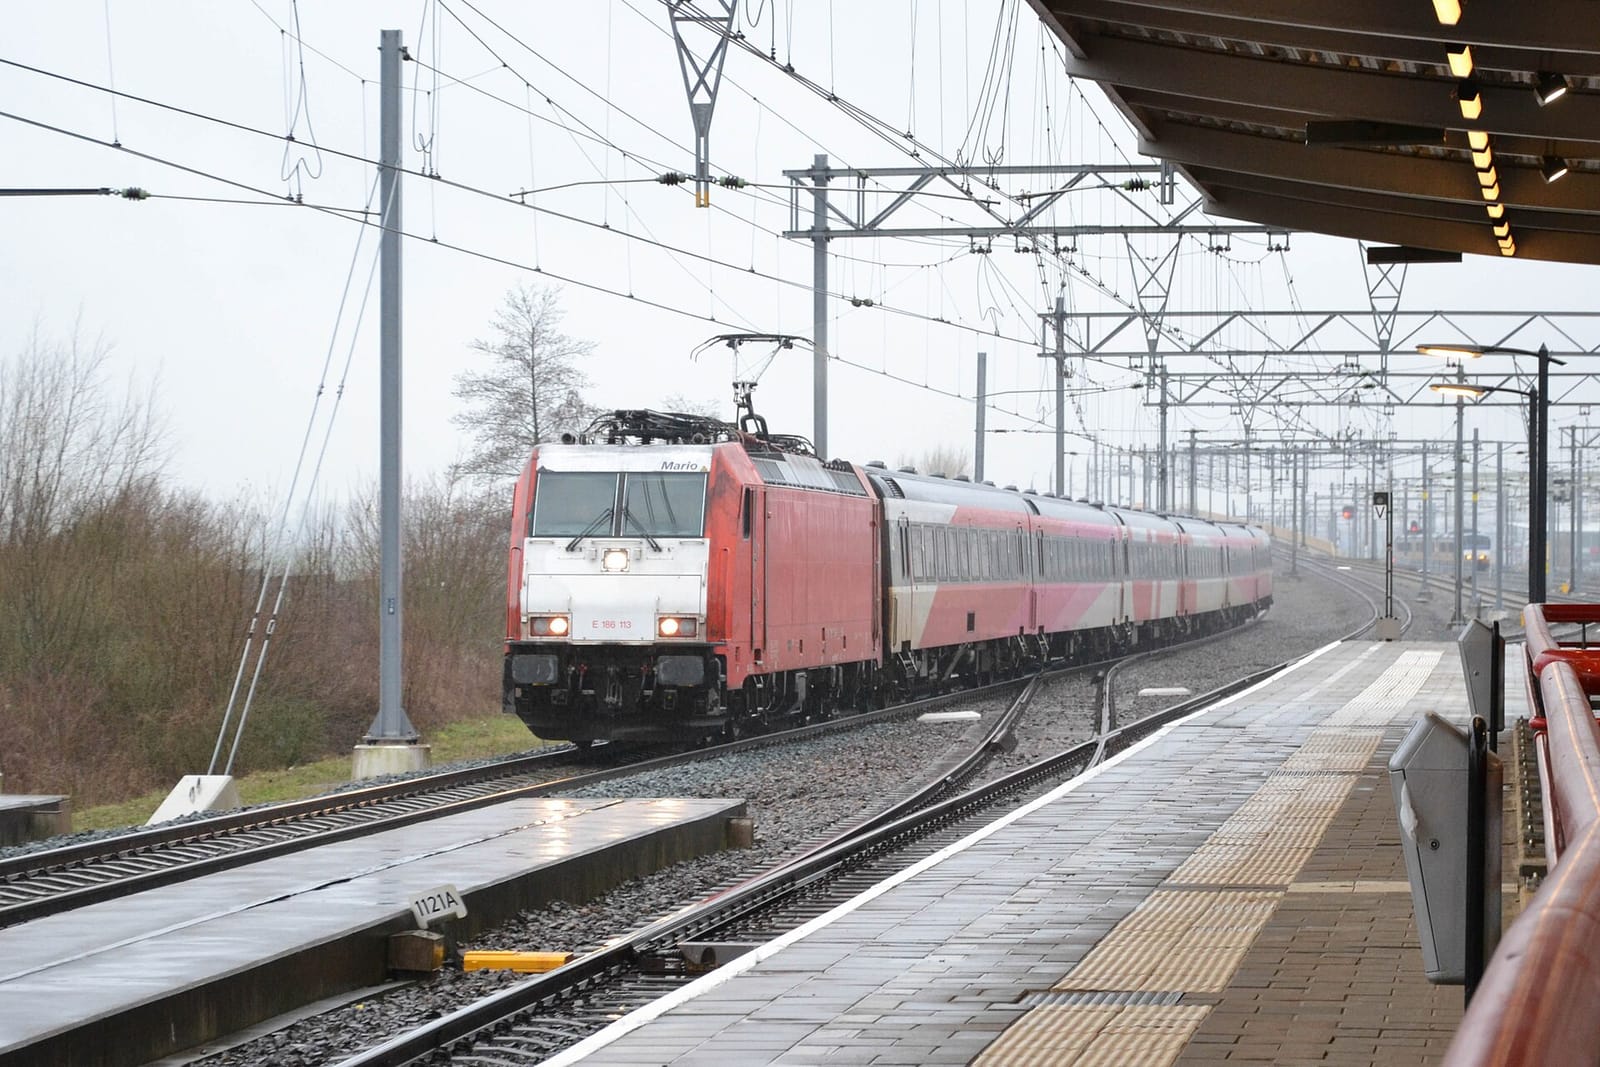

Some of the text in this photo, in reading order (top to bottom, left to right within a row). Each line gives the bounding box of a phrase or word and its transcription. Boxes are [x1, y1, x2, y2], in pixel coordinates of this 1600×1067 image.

[661, 461, 698, 471] Mario
[1375, 506, 1385, 519] V
[592, 620, 632, 629] E 186 113
[415, 891, 459, 917] 1121A
